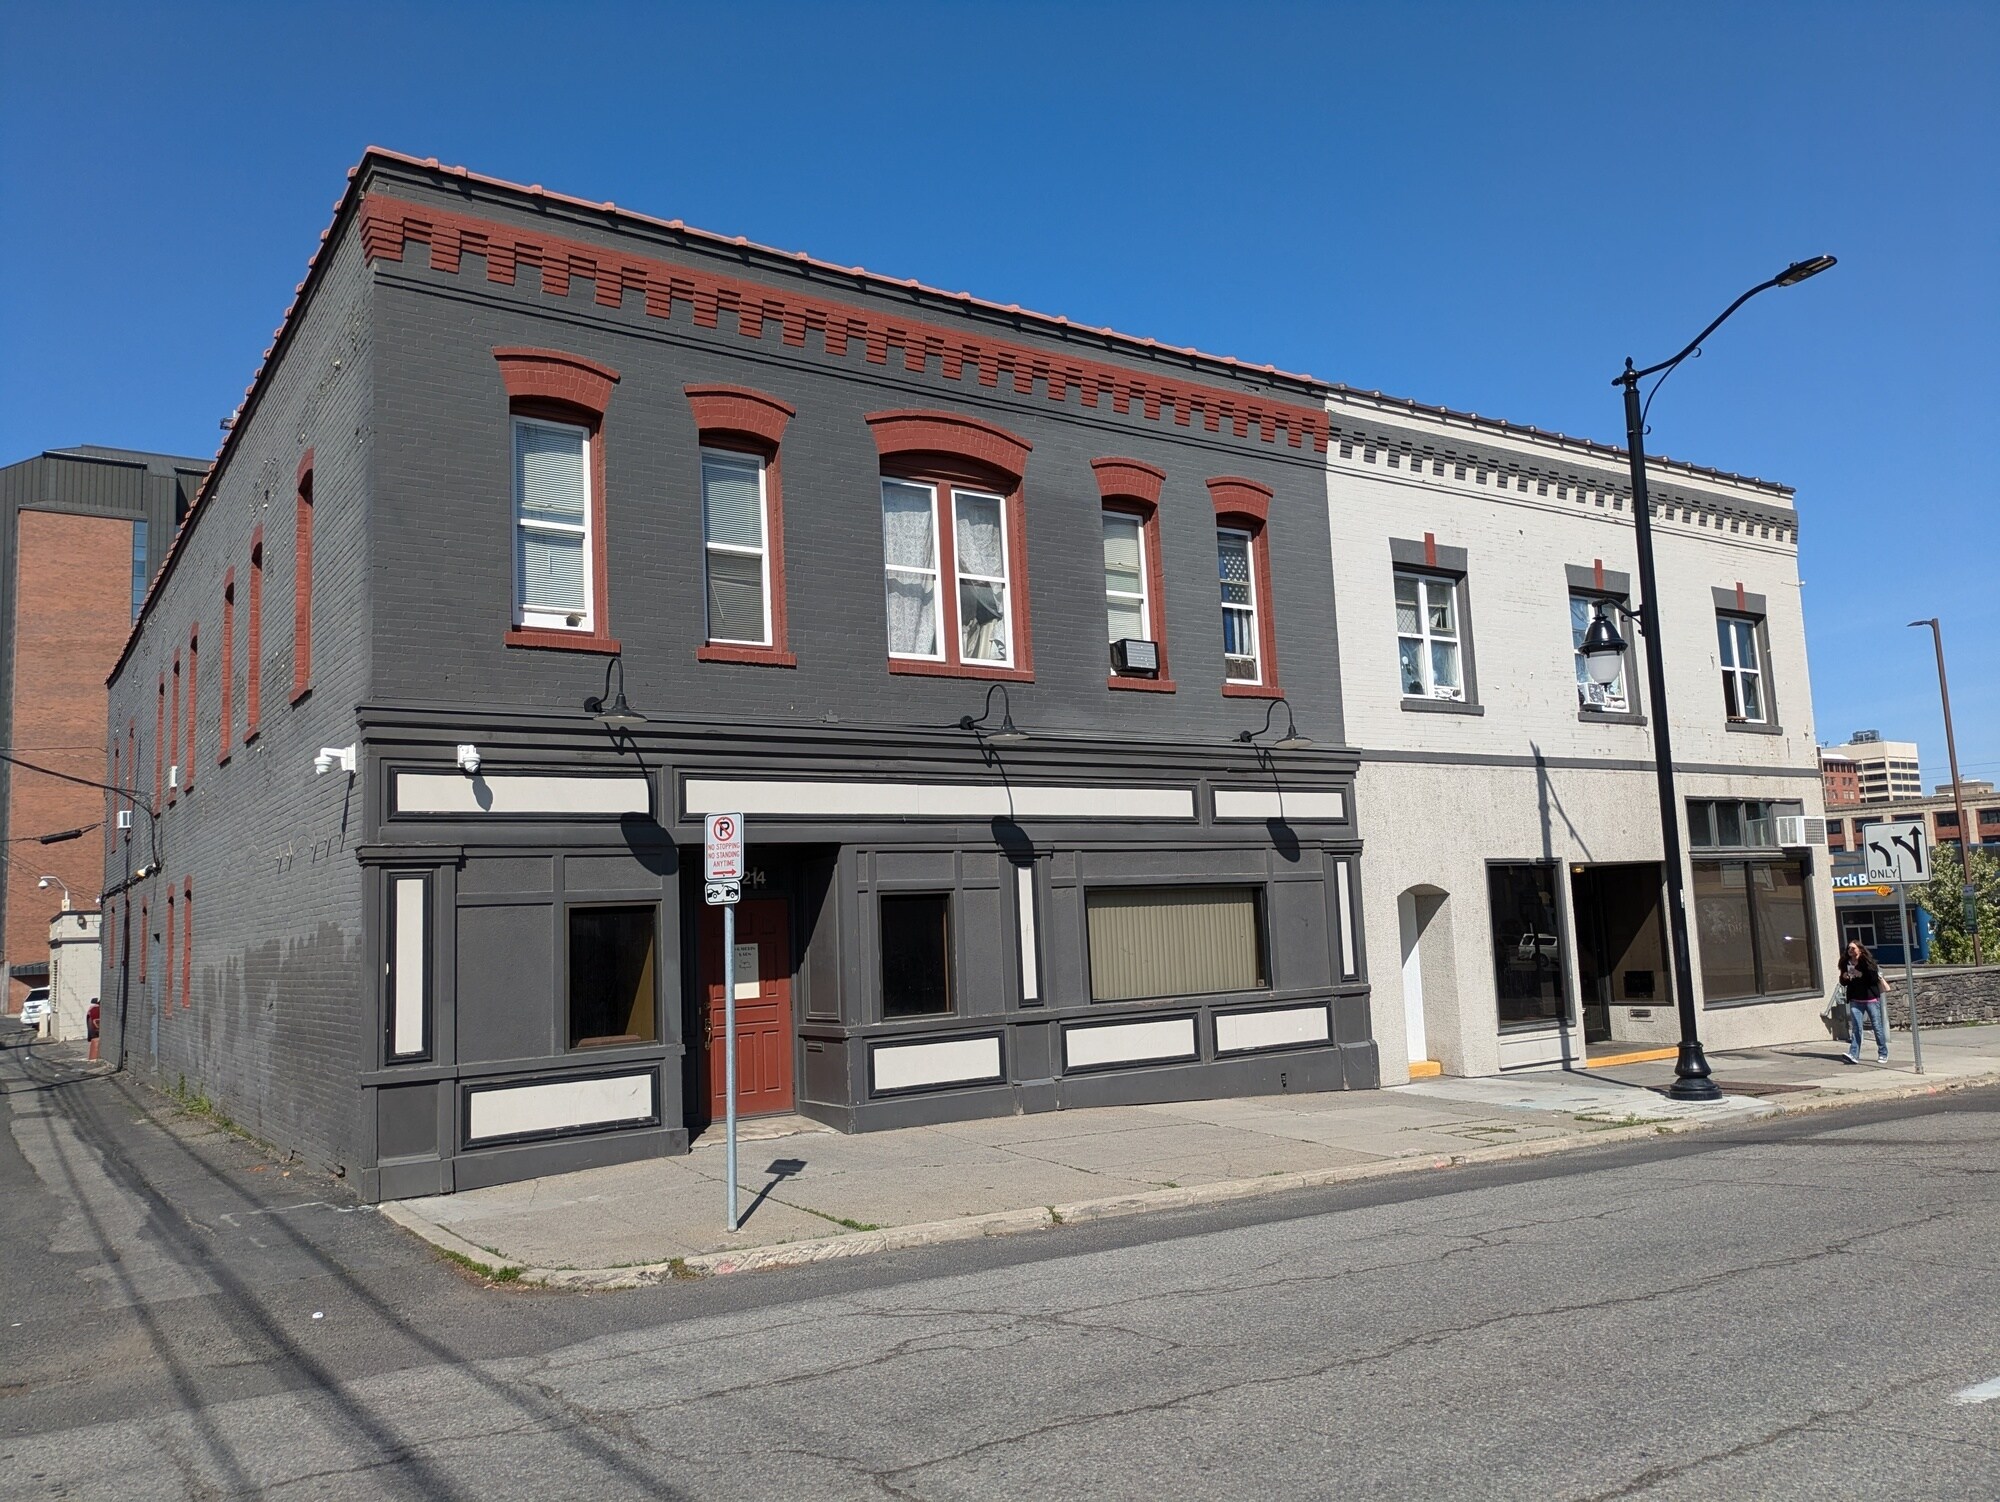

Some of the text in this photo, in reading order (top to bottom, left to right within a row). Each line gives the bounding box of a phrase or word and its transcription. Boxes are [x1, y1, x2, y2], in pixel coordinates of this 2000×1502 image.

[716, 842, 740, 850] STOPPING
[716, 850, 740, 859] STANDING
[713, 859, 735, 868] ANYTIME
[742, 871, 766, 885] 214
[1870, 868, 1897, 879] ONLY
